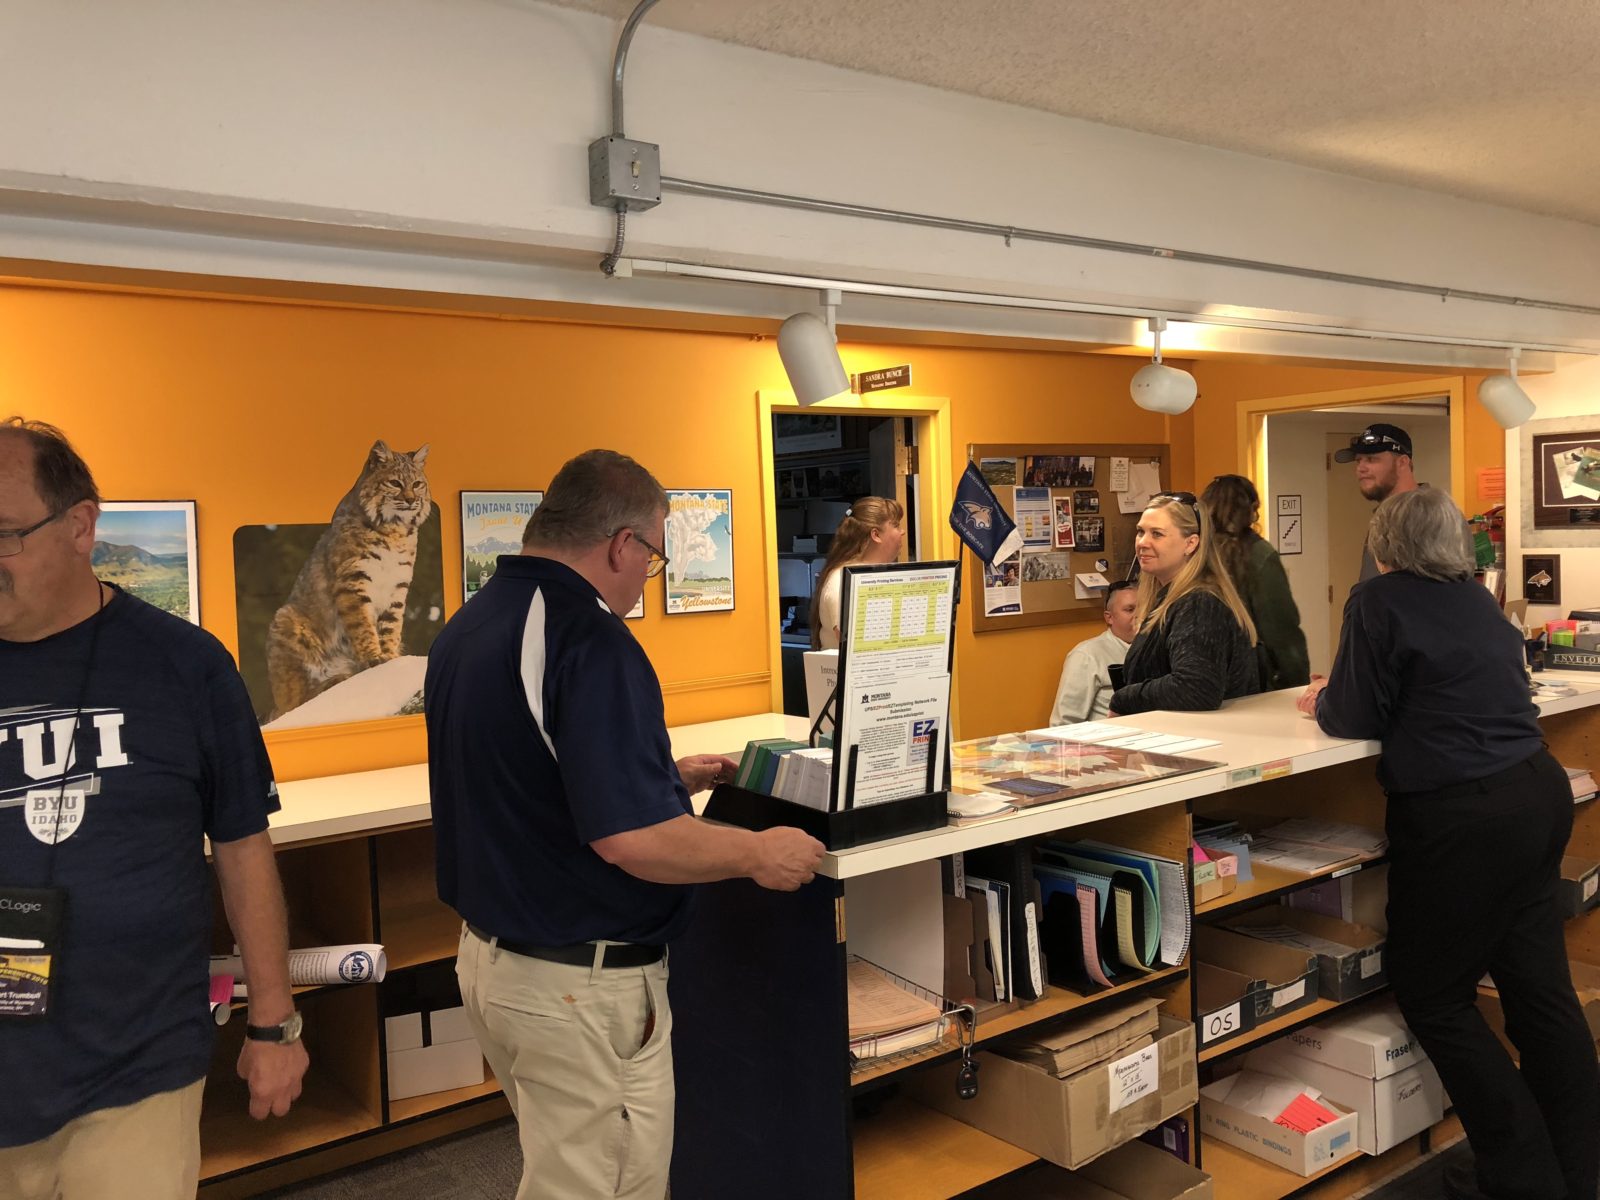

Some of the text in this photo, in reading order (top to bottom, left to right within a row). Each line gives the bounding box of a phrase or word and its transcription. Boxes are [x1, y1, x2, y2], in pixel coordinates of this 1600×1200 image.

[467, 503, 512, 518] MONTANA
[1282, 500, 1296, 509] EXIT
[681, 595, 731, 610] Yellowstone
[913, 720, 935, 737] EZ
[0, 713, 128, 780] UI
[912, 736, 930, 744] PRIN
[33, 796, 78, 811] BYU
[31, 814, 77, 825] IDAHO
[1210, 1012, 1232, 1035] OS
[1385, 1042, 1413, 1062] Fraser
[1233, 1126, 1259, 1142] PLASTIC
[1262, 1138, 1292, 1156] BINDINGS
